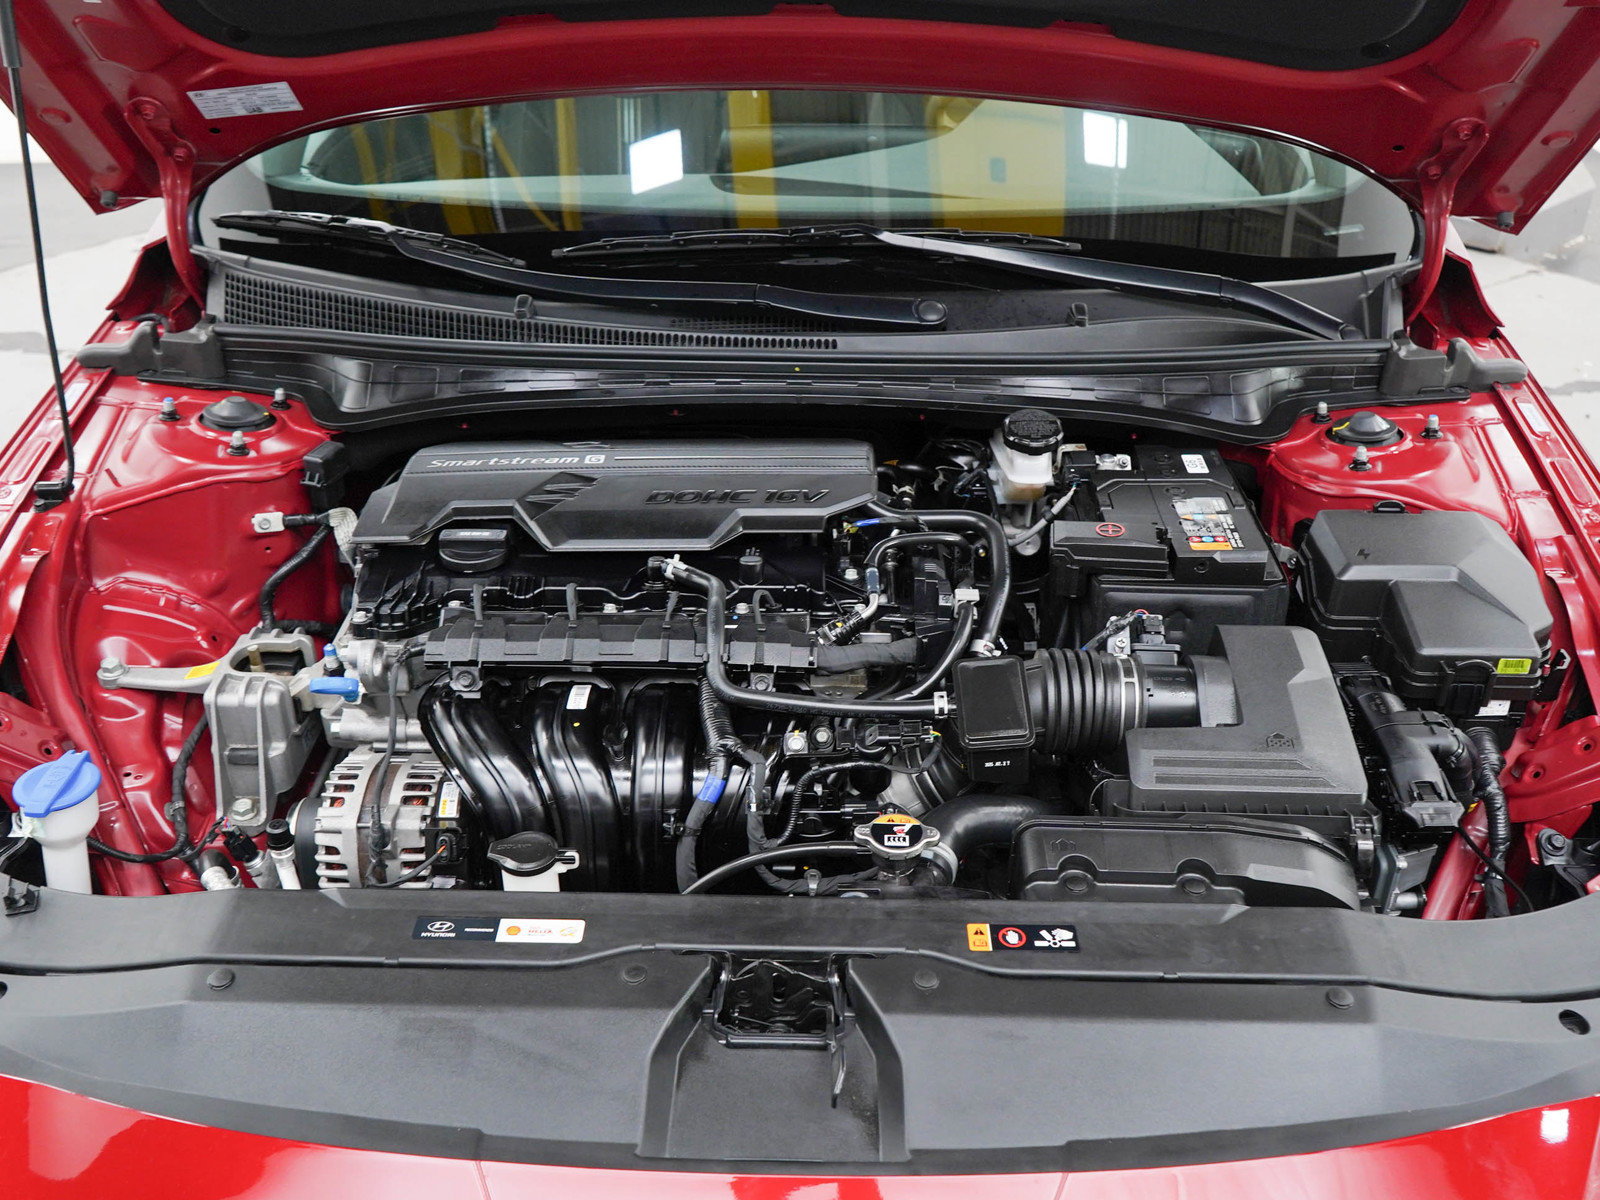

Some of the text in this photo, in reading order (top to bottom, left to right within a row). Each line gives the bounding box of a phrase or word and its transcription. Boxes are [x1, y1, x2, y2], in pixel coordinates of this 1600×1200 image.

[427, 456, 580, 468] Smartstream
[645, 489, 830, 505] DOHC 16V
